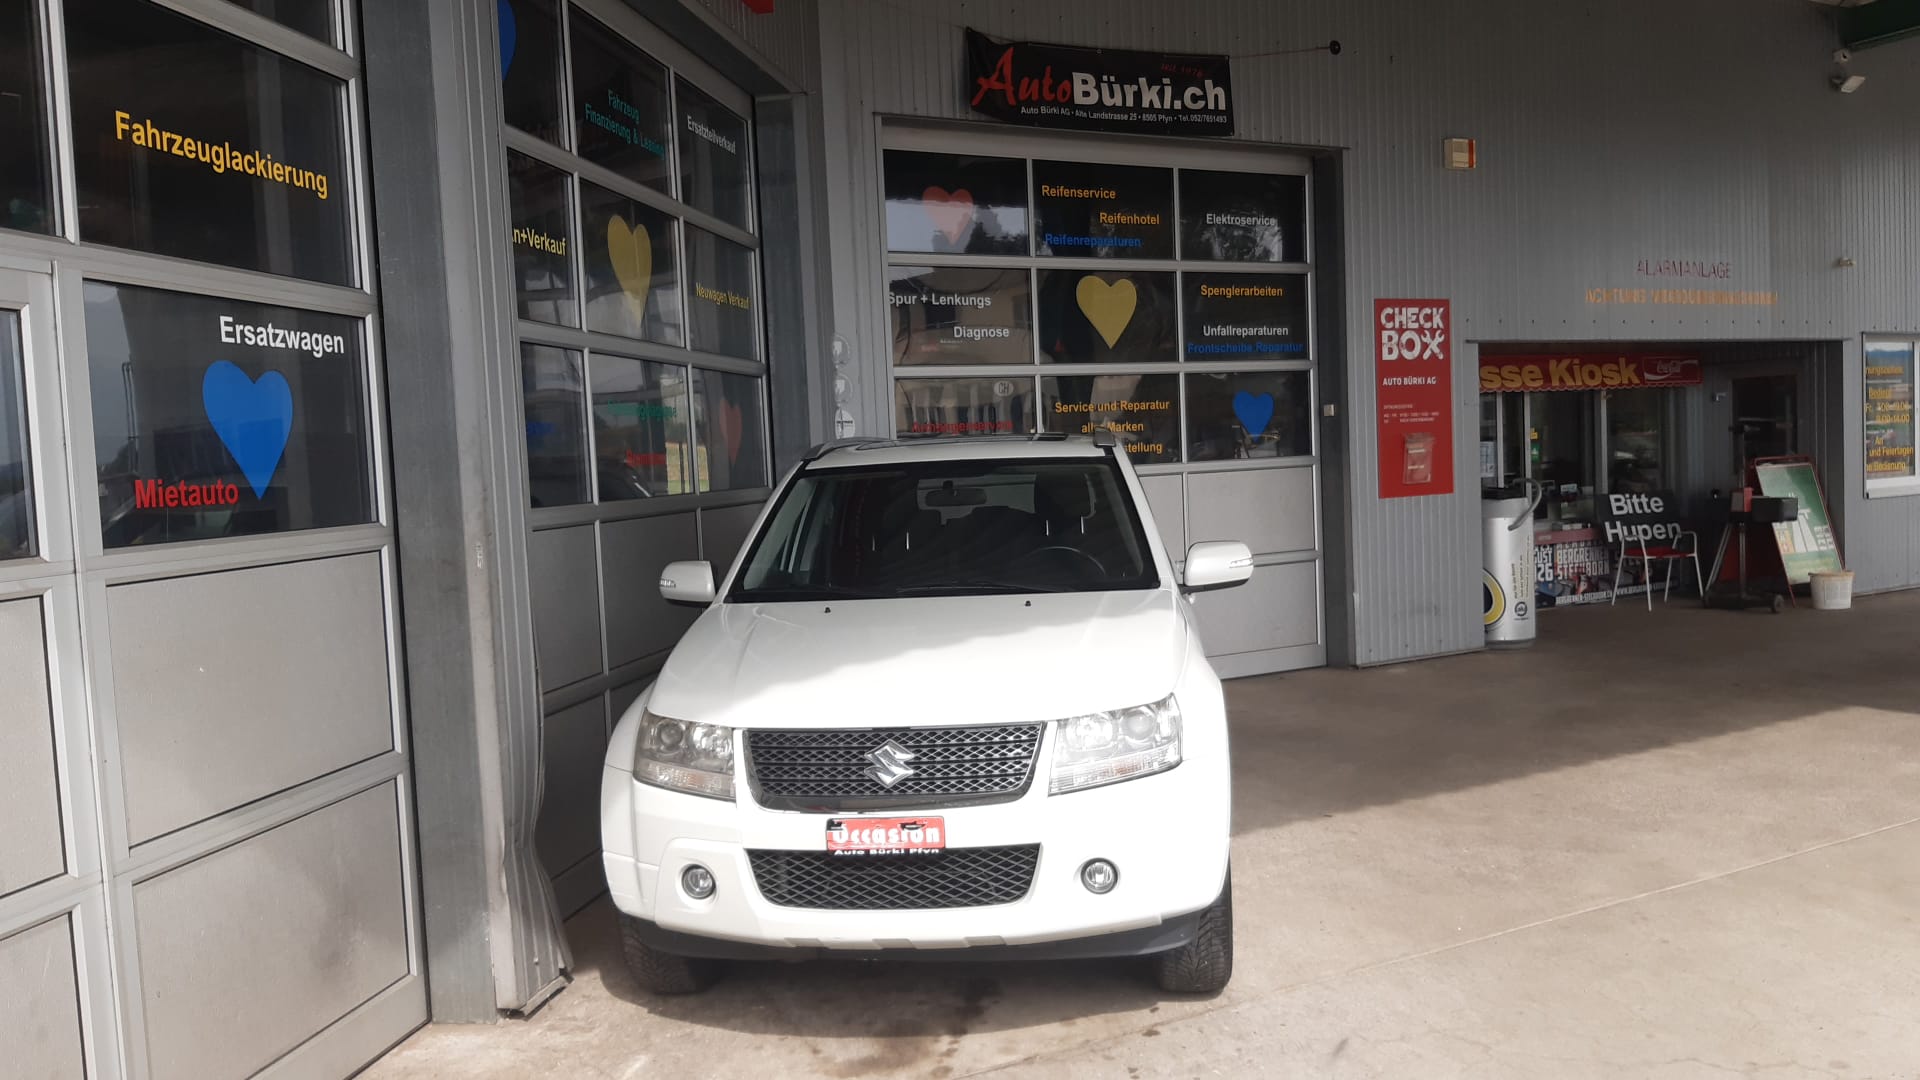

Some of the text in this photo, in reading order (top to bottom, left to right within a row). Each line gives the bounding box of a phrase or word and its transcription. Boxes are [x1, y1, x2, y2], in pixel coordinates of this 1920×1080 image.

[971, 47, 1226, 110] AutoBürki.ch
[608, 89, 640, 124] Fahrzeug
[1021, 106, 1039, 115] Auto
[1041, 105, 1060, 115] Bürki
[1060, 107, 1070, 116] AG
[1075, 109, 1087, 118] Alte
[1088, 110, 1129, 120] Landstrasse
[585, 103, 631, 144] Finanzierung
[633, 128, 639, 144] &
[687, 115, 737, 155] Ersatzteilverkauf
[115, 110, 328, 199] Fahrzeuglackierung
[1041, 185, 1117, 199] Reifenservice
[1099, 212, 1160, 225] Reifenhotel
[1206, 213, 1276, 226] Elektroservice
[512, 228, 567, 257] n+Verkauf
[1045, 233, 1142, 248] Reifenreparaturen
[1637, 259, 1730, 279] ALARMANLAGE
[696, 282, 728, 306] Neuwagen
[888, 292, 918, 308] Spur
[932, 293, 992, 309] Lenkungs
[1200, 284, 1284, 298] Spenglerarbeiten
[1380, 307, 1444, 329] CHECK
[219, 315, 345, 359] Ersatzwagen
[954, 326, 1010, 340] Diagnose
[1203, 325, 1289, 338] Unfallreparaturen
[1188, 342, 1253, 354] Frontscheibe
[1381, 329, 1445, 361] BOX
[1382, 376, 1437, 386] AUTO BÜRKI AG
[1549, 357, 1641, 387] Kiosk
[998, 382, 1010, 394] CH
[1055, 400, 1171, 413] Service und Reparatur
[1081, 421, 1144, 433] all Marken
[134, 479, 239, 509] Mietauto
[1609, 493, 1665, 515] Bitte
[1604, 520, 1682, 543] Hupen
[833, 826, 940, 845] Occasion
